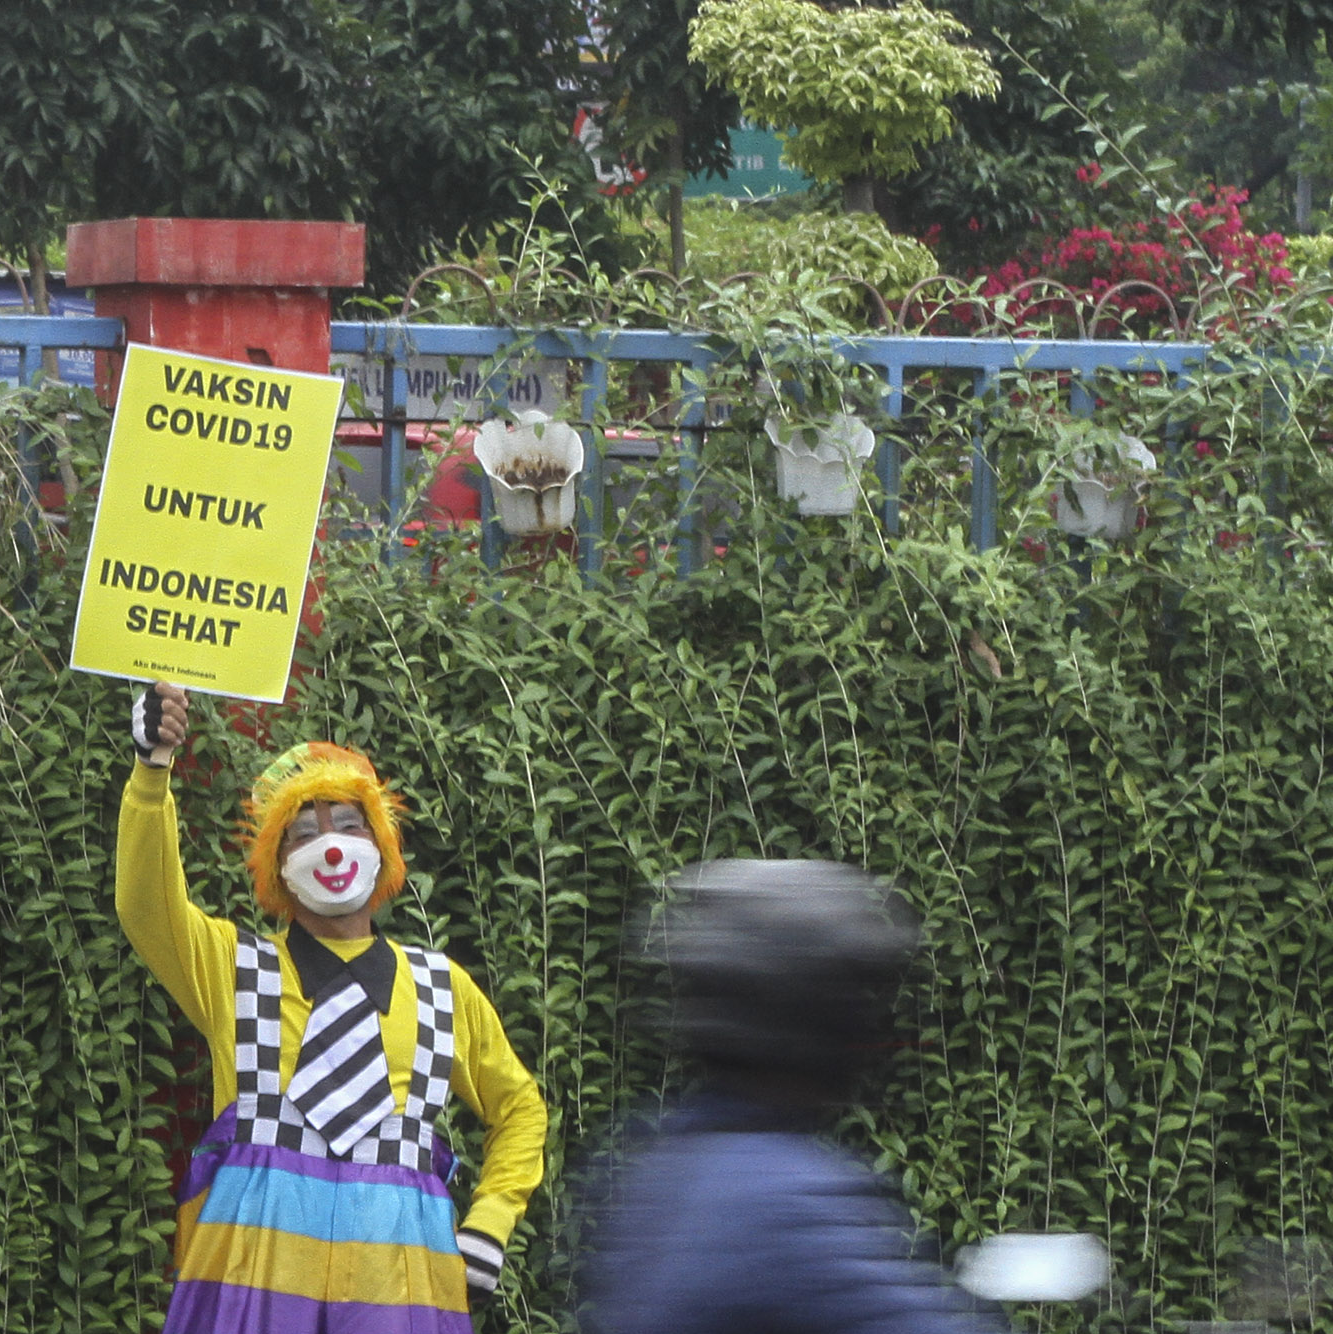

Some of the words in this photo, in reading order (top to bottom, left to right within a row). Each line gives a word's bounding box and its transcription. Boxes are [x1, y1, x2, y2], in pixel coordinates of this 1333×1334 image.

[164, 364, 292, 411] VAKSIN
[145, 404, 293, 452] COVID19
[143, 484, 268, 530] UNTUK
[99, 558, 289, 615] INDONESIA
[126, 604, 241, 647] SEHAT
